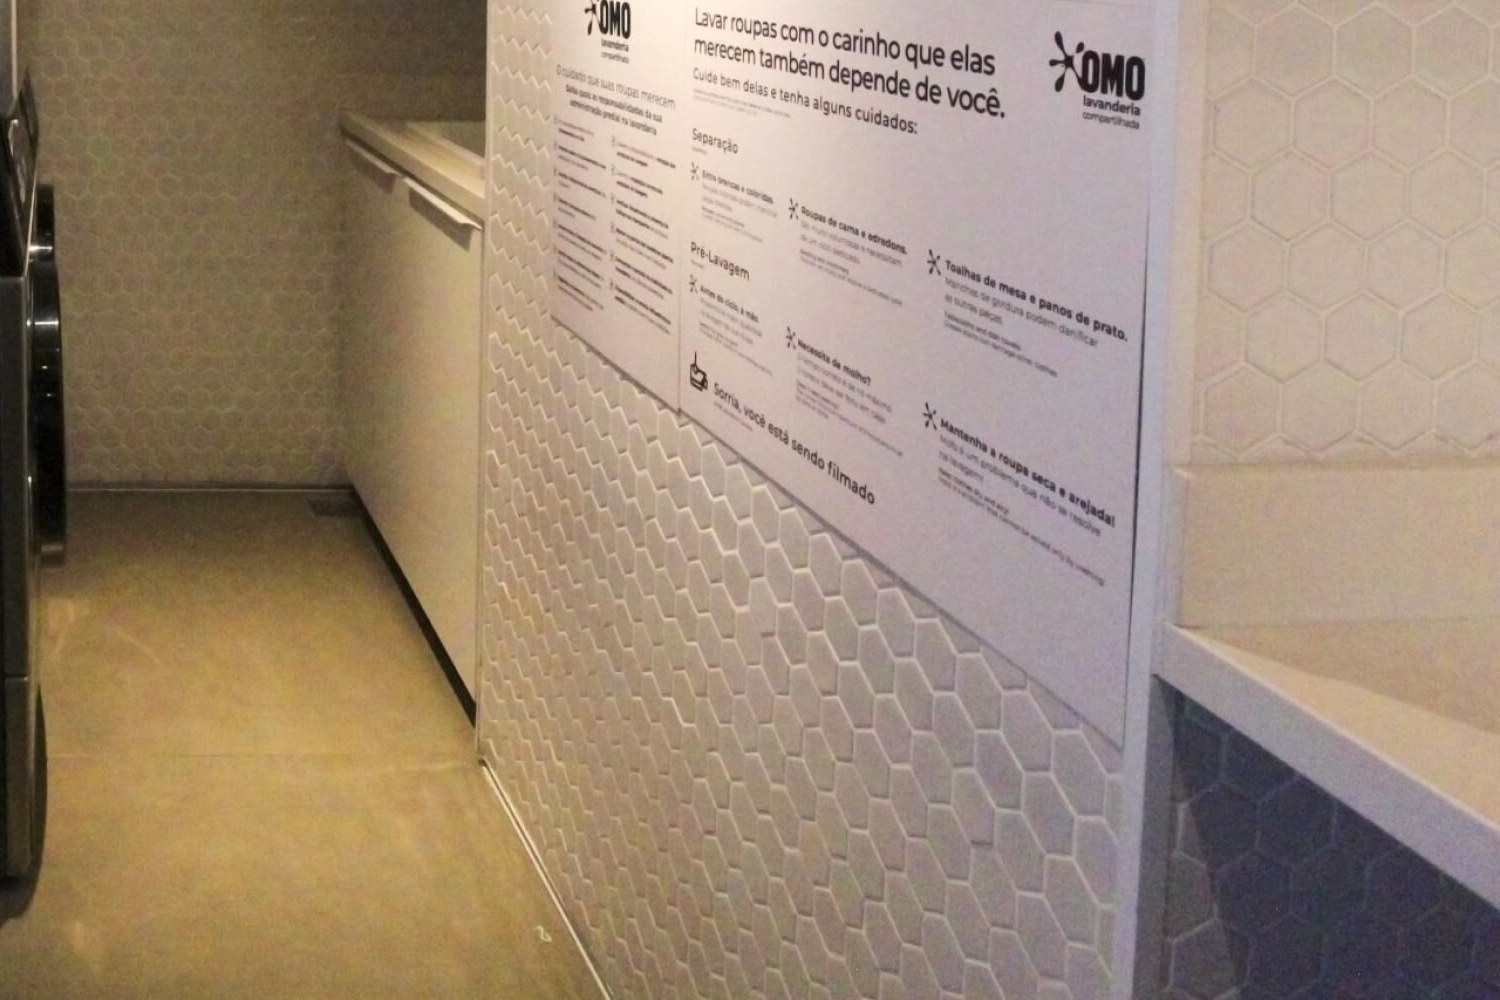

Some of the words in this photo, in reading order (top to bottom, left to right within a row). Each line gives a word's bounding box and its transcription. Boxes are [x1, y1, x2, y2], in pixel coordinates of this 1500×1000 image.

[600, 0, 631, 39] OMO
[695, 7, 727, 31] Lavar
[731, 15, 777, 40] roupas
[781, 23, 814, 45] com
[818, 29, 829, 47] o
[832, 28, 901, 59] carinho
[905, 42, 946, 70] que
[950, 44, 996, 76] elas
[693, 67, 718, 86] Cuide
[720, 72, 741, 91] bem
[743, 79, 769, 99] delas
[771, 88, 777, 99] e
[779, 88, 810, 108] tenha
[813, 96, 852, 118] alguns
[855, 106, 918, 135] cuidados:
[694, 39, 756, 66] merecem
[760, 49, 825, 80] também
[829, 60, 911, 97] depende
[915, 76, 942, 104] de
[946, 88, 1005, 119] você.
[1082, 50, 1145, 101] OMO
[1084, 94, 1140, 116] lavanderia
[692, 128, 739, 154] Separação
[828, 217, 837, 228] de
[861, 230, 866, 238] e
[690, 241, 750, 281] Pré-Lavagem
[945, 259, 981, 283] Toalhas
[984, 275, 996, 288] de
[999, 282, 1026, 301] mesa
[1030, 293, 1036, 304] e
[1039, 298, 1072, 320] panos
[1075, 312, 1090, 326] de
[1093, 319, 1128, 342] prato.
[713, 382, 742, 413] Sorria,
[744, 405, 766, 428] você
[768, 423, 789, 446] está
[791, 439, 825, 470] sendo
[827, 461, 875, 505] filmado
[941, 418, 988, 453] Mantenha
[990, 448, 996, 458] a
[999, 453, 1029, 477] roupa
[1031, 472, 1056, 491] seca
[1059, 487, 1066, 497] e
[1069, 492, 1115, 528] arejada!
